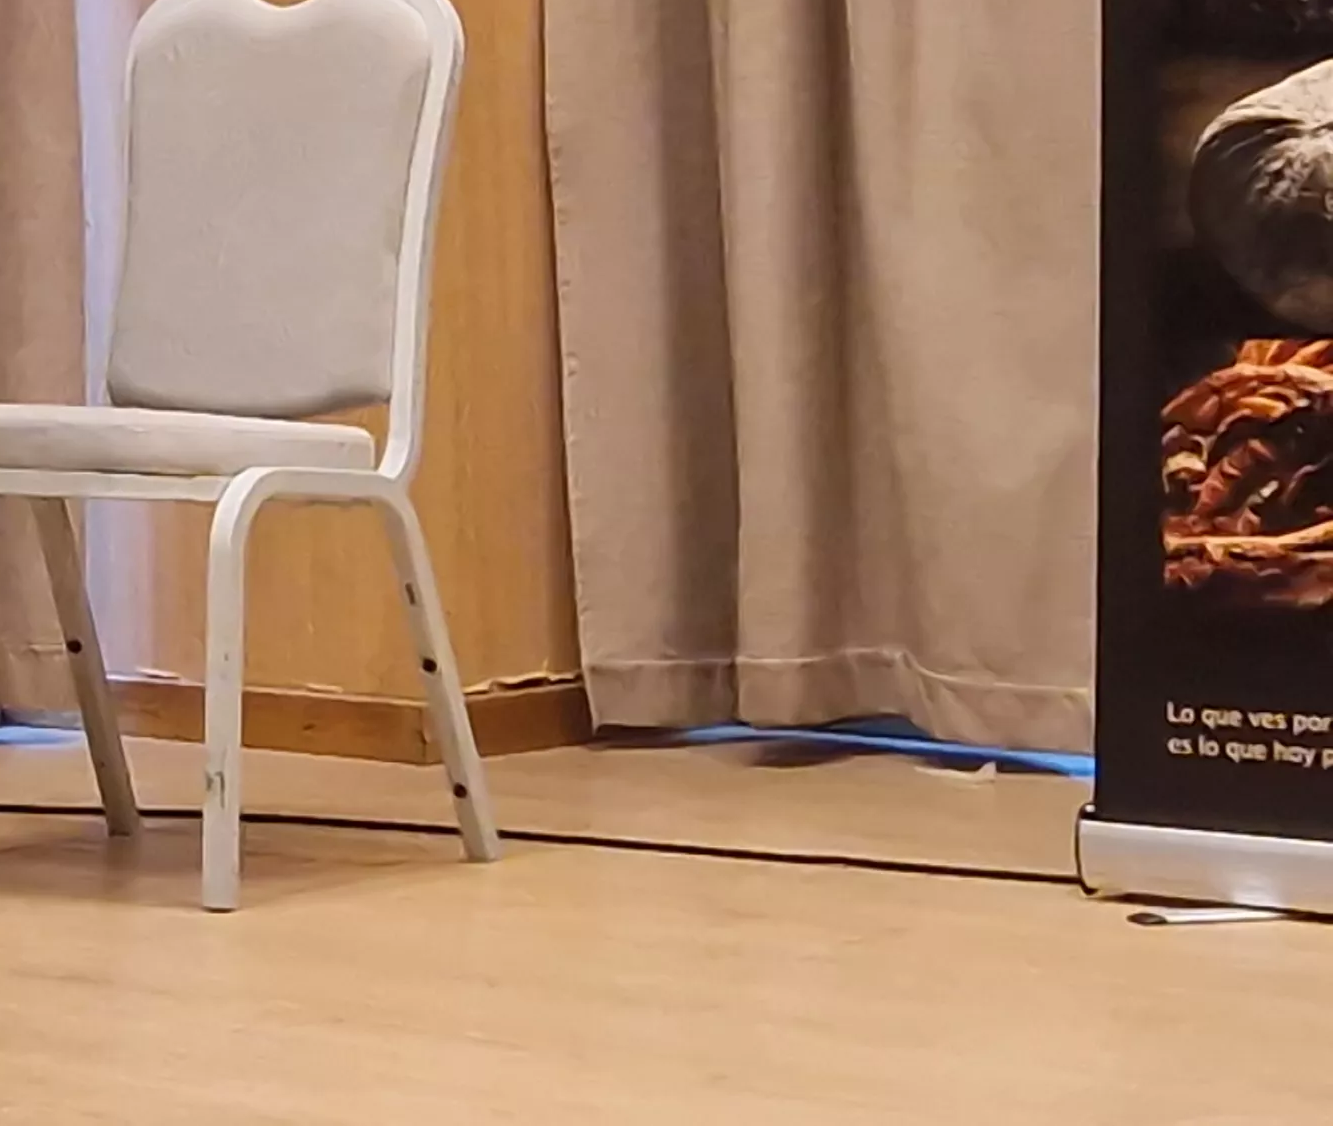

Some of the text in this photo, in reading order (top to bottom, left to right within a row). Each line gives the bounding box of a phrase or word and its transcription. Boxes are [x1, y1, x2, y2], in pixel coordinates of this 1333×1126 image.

[1166, 700, 1333, 736] Lo que ves por
[1167, 736, 1194, 755] es
[1198, 734, 1220, 757] lo
[1225, 741, 1267, 763] que
[1273, 739, 1316, 768] hay
